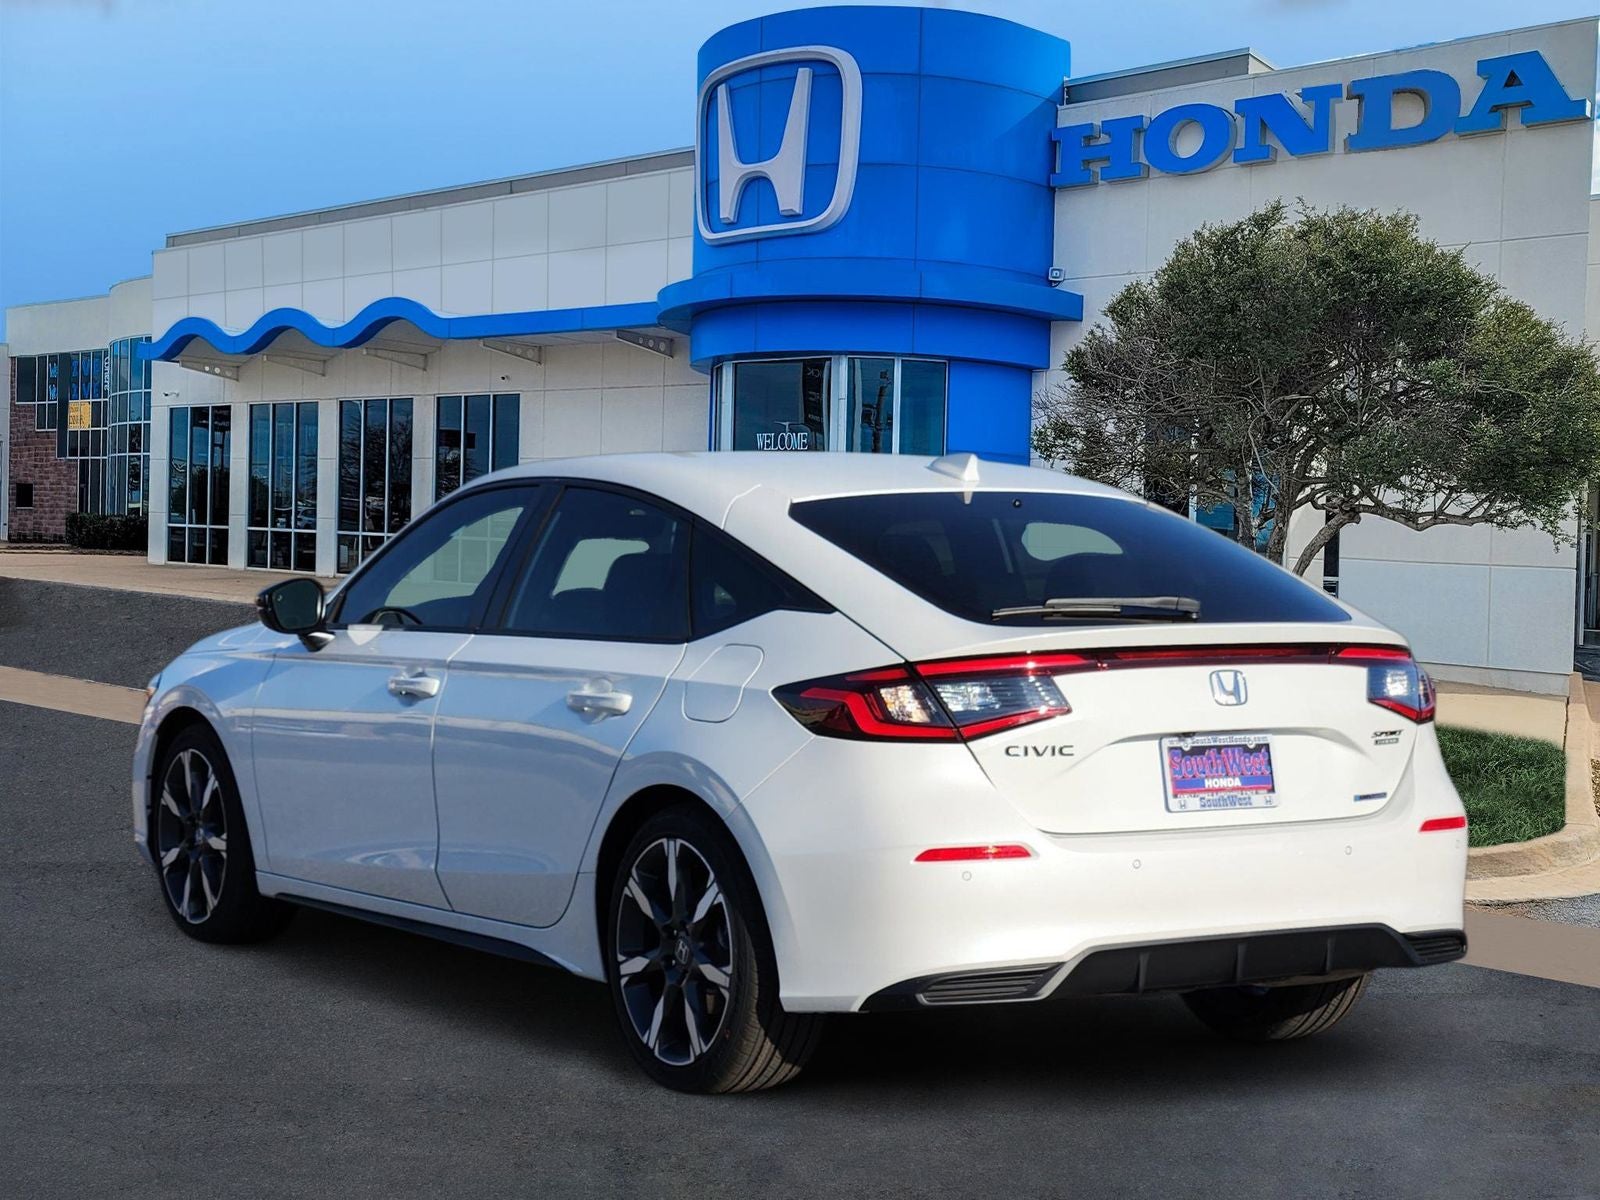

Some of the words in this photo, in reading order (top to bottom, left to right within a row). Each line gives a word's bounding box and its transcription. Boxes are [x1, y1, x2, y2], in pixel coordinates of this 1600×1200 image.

[1051, 50, 1592, 188] HONDA
[756, 432, 808, 450] WELCOME
[1005, 745, 1074, 757] CIVIC
[1168, 747, 1271, 779] SouthWest
[1204, 777, 1242, 788] HONDA
[1199, 796, 1253, 808] SouthWest
